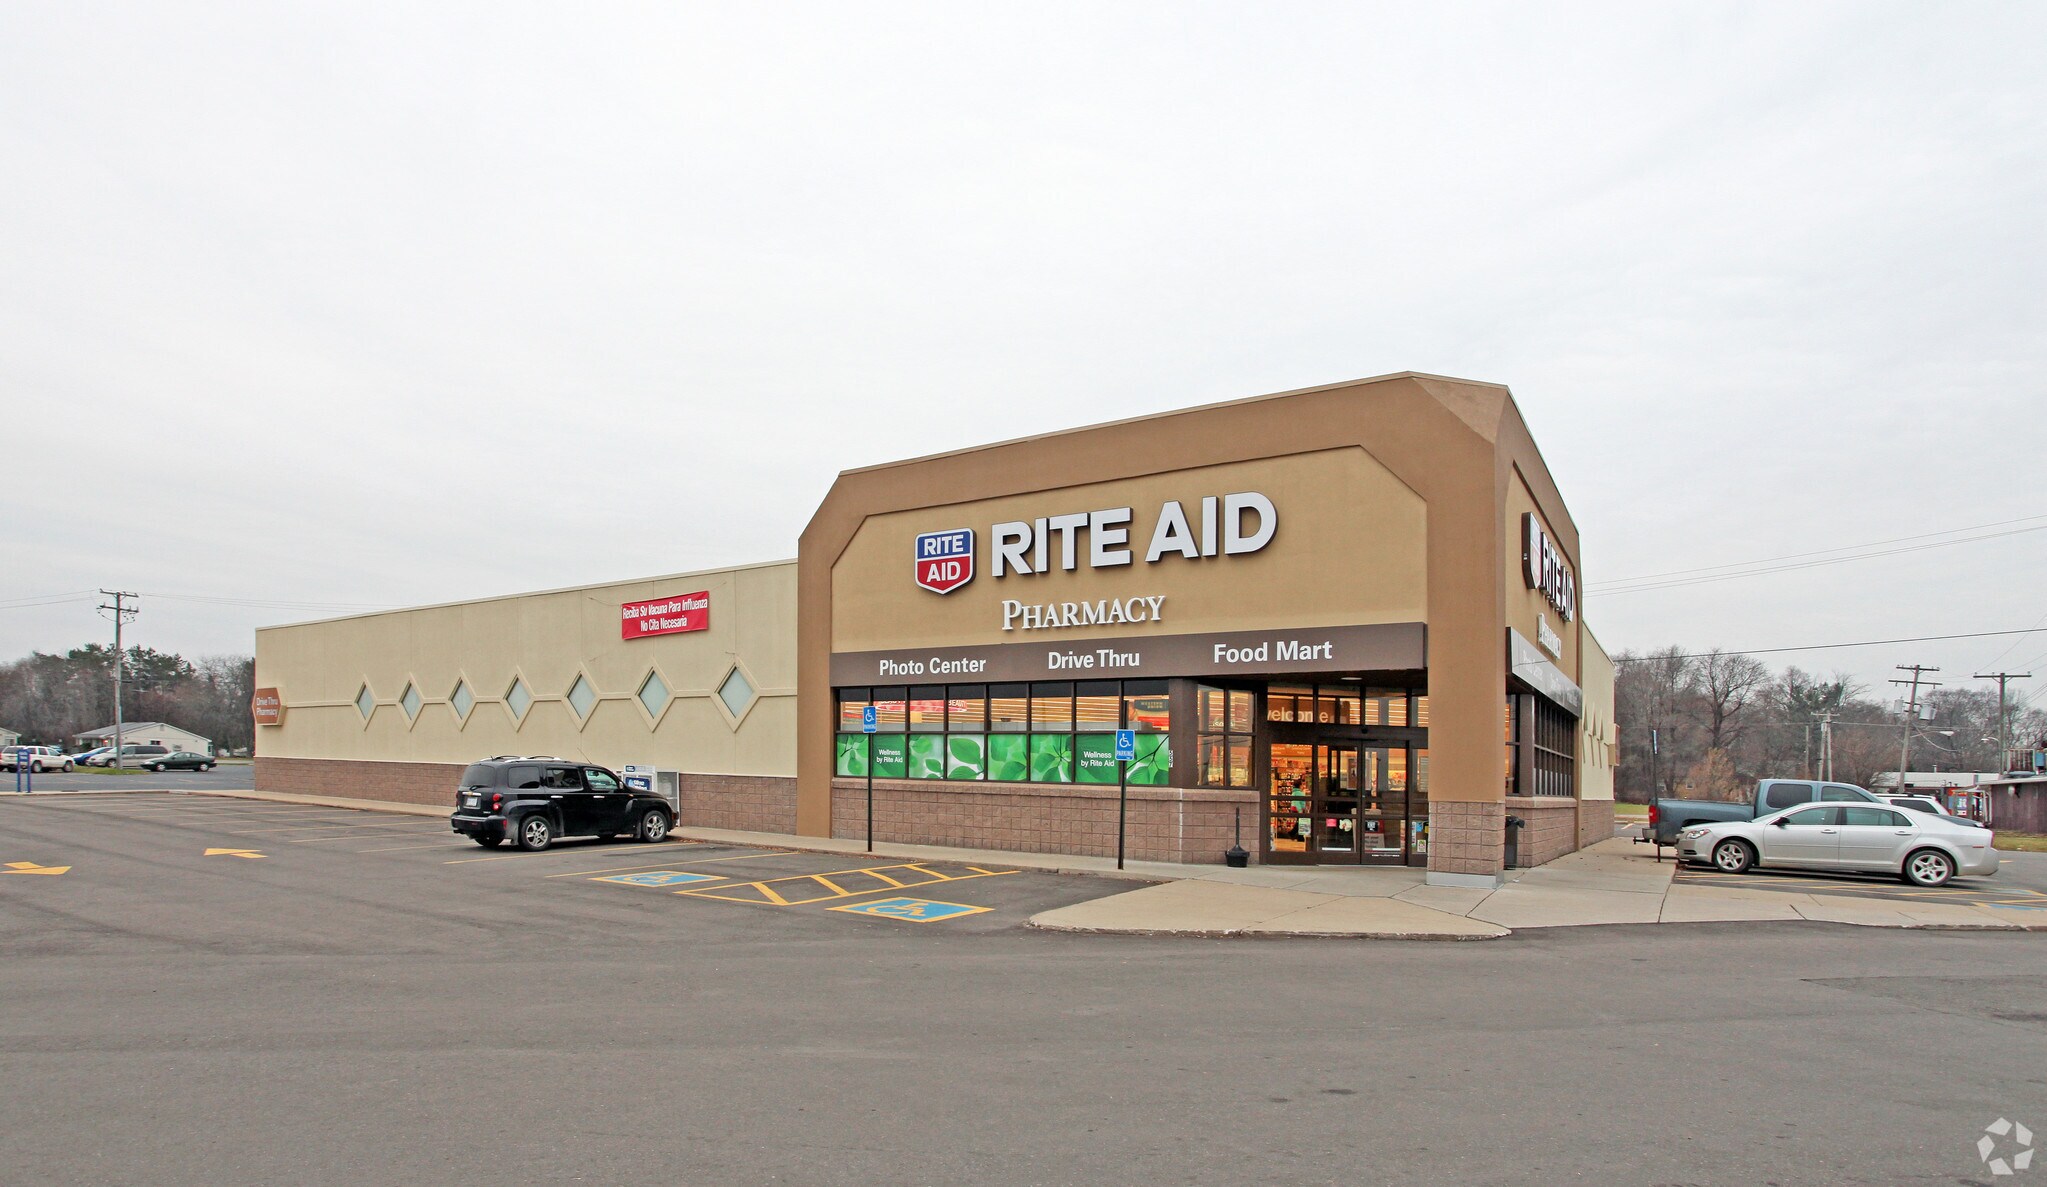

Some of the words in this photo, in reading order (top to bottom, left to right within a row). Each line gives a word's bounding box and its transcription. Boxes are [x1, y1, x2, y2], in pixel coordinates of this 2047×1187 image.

[992, 507, 1133, 578] RITE
[1145, 491, 1278, 562] AID
[924, 534, 964, 556] RITE
[926, 561, 961, 583] AID
[623, 607, 639, 619] Reciba
[640, 606, 647, 616] Su
[649, 604, 667, 615] Vacuna
[669, 602, 680, 612] Para
[682, 599, 707, 611] Influenza
[1002, 595, 1166, 631] PHARMACY
[641, 620, 648, 631] No
[649, 619, 659, 630] Cita
[661, 615, 687, 629] Necesaria
[1048, 651, 1094, 670] Drive
[1096, 649, 1140, 668] Thru
[1214, 642, 1268, 663] Food
[1276, 640, 1333, 661] Mart
[879, 659, 924, 676] Photo
[929, 657, 986, 674] Center
[876, 756, 883, 764] by
[1080, 760, 1089, 768] by
[1083, 750, 1112, 759] Wellness
